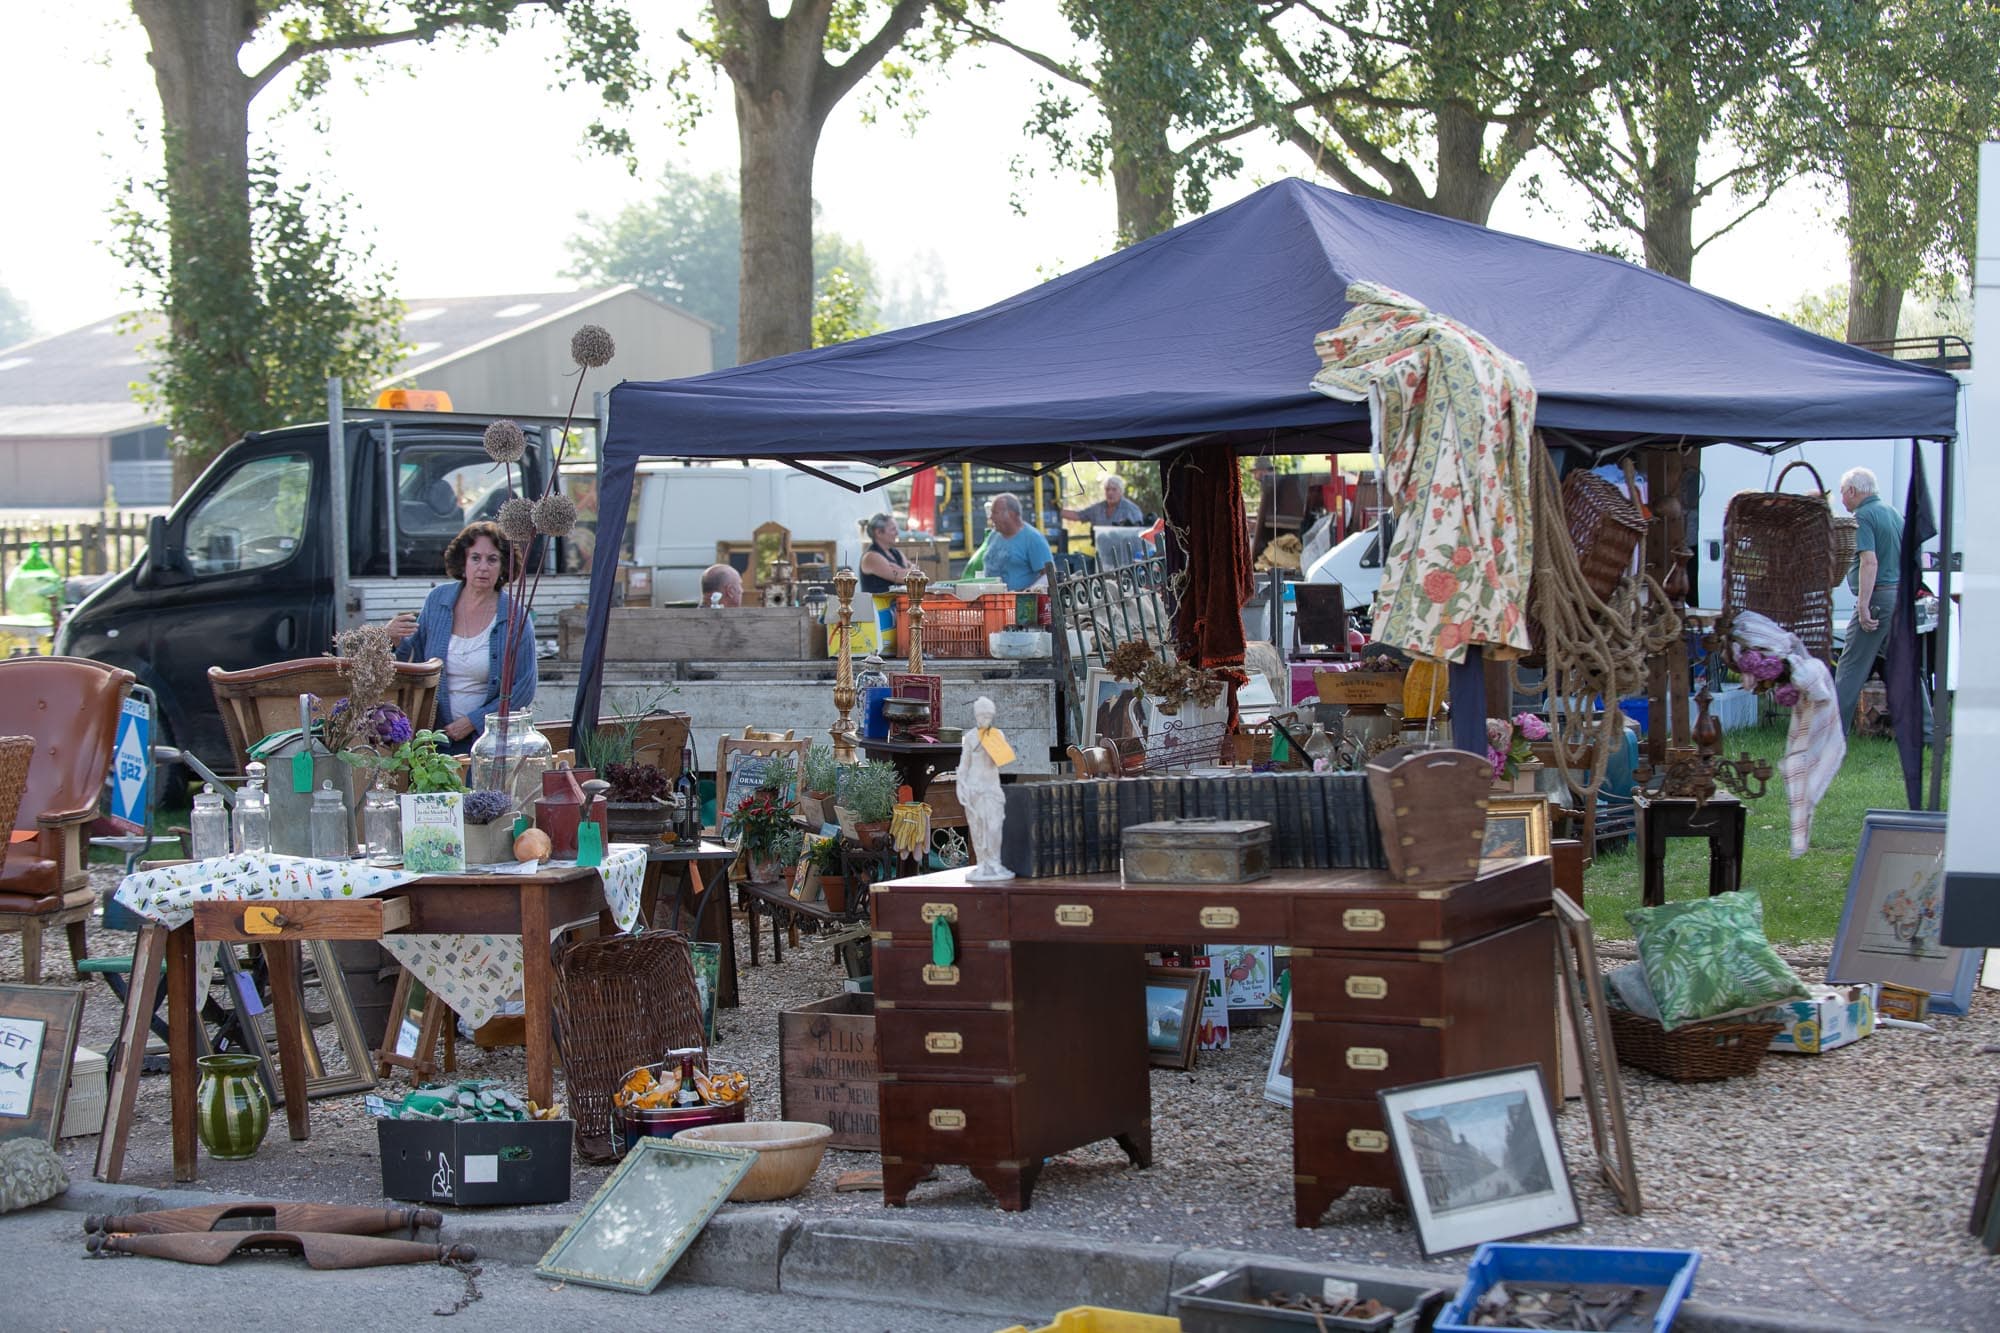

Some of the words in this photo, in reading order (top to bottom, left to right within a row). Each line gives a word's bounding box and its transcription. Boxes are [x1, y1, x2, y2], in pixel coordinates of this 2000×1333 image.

[123, 700, 147, 717] ERVICE
[121, 761, 141, 781] gaz
[818, 1031, 864, 1053] ELLIS
[814, 1085, 840, 1102] WINE
[848, 1088, 879, 1105] MERC
[828, 1111, 880, 1136] RICHMO
